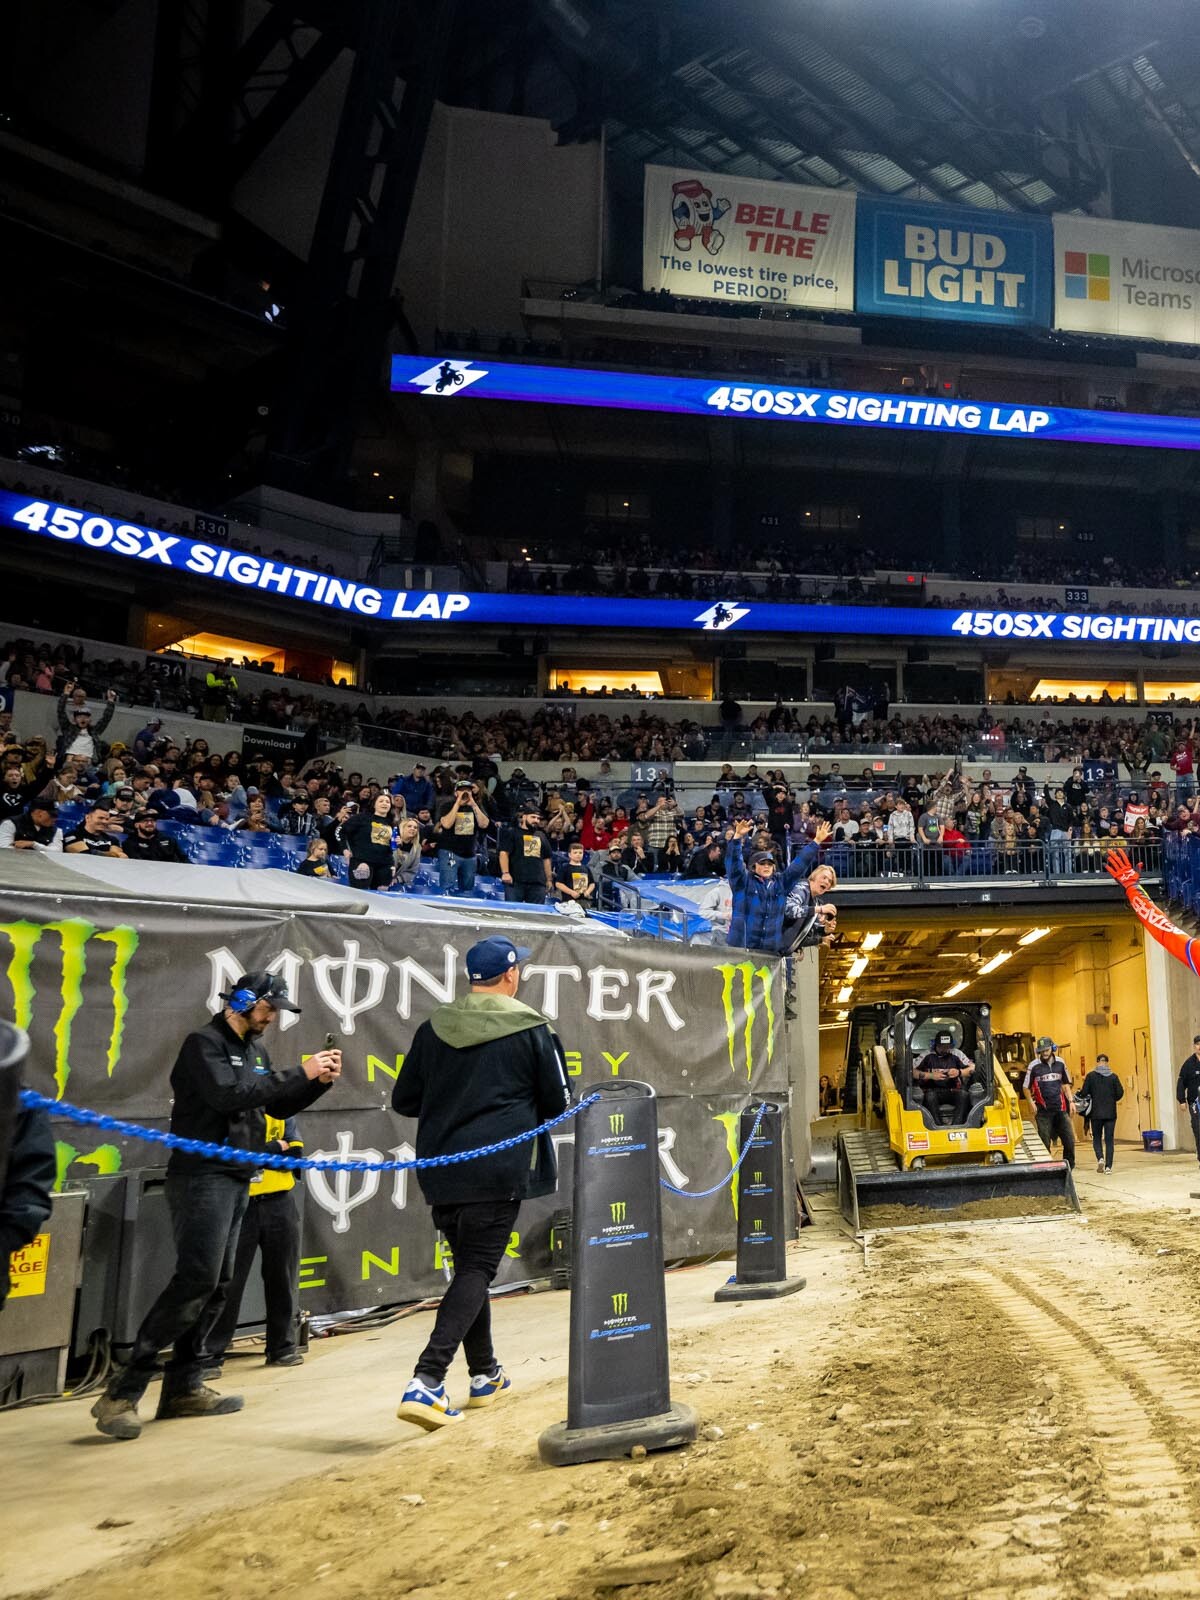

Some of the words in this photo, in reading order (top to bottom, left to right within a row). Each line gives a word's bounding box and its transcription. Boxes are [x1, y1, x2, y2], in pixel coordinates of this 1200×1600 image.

[734, 203, 830, 236] BELLE
[745, 230, 815, 260] TIRE
[904, 225, 1007, 267] BUD
[660, 255, 691, 274] The
[697, 262, 752, 282] lowest
[757, 268, 789, 287] tire
[792, 273, 839, 293] price,
[884, 260, 1025, 308] LIGHT
[712, 279, 788, 302] PERIOD!
[1123, 285, 1192, 311] Teams
[0, 409, 22, 426] 30
[706, 386, 818, 419] 450SX
[826, 395, 982, 430] SIGHTING
[988, 407, 1049, 434] LAP
[197, 518, 227, 537] 330
[13, 501, 181, 565] 450SX
[185, 543, 382, 616] SIGHTING
[391, 590, 471, 620] LAP
[1066, 590, 1088, 602] 333
[952, 611, 1056, 638] 450SX
[243, 734, 291, 750] Download
[635, 767, 669, 782] 13
[1087, 768, 1115, 782] 13
[206, 940, 686, 1035] MONTER
[949, 1132, 967, 1141] CAT
